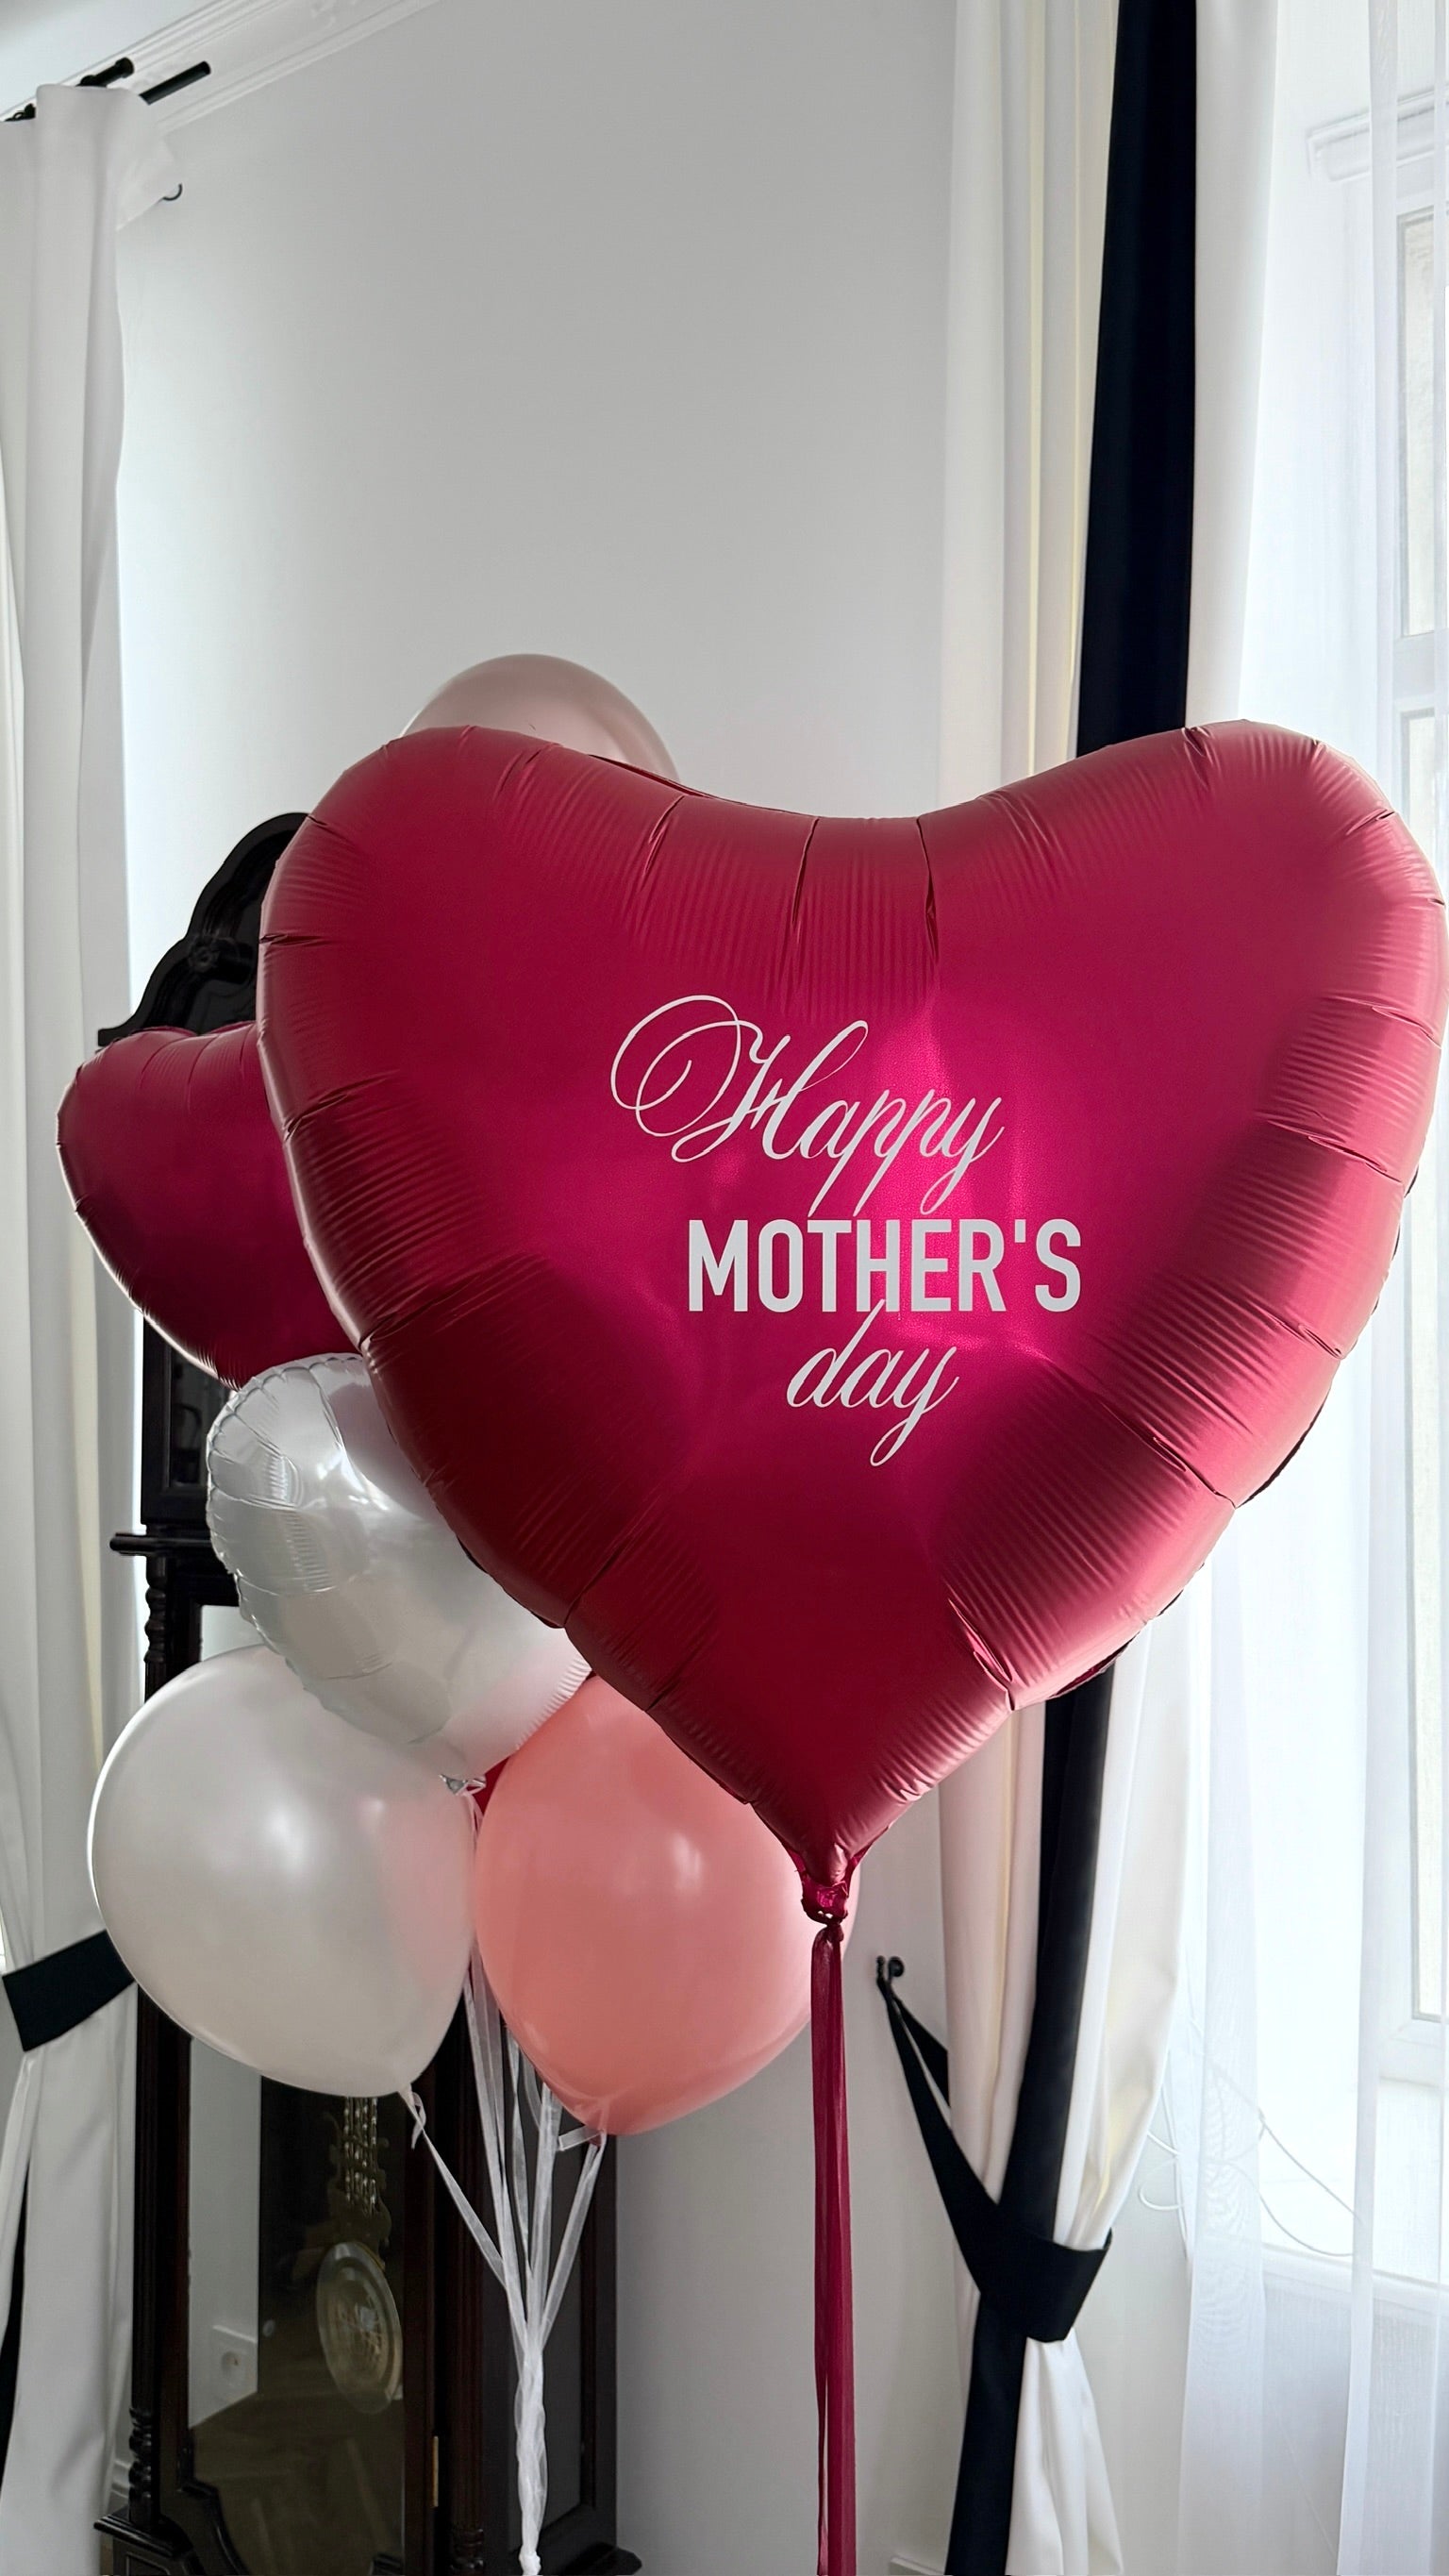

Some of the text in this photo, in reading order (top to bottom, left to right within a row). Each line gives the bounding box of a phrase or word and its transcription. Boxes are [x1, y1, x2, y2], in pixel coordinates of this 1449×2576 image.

[610, 995, 1005, 1217] Happy
[688, 1218, 1081, 1313] MOTHER'S
[786, 1299, 959, 1466] day
